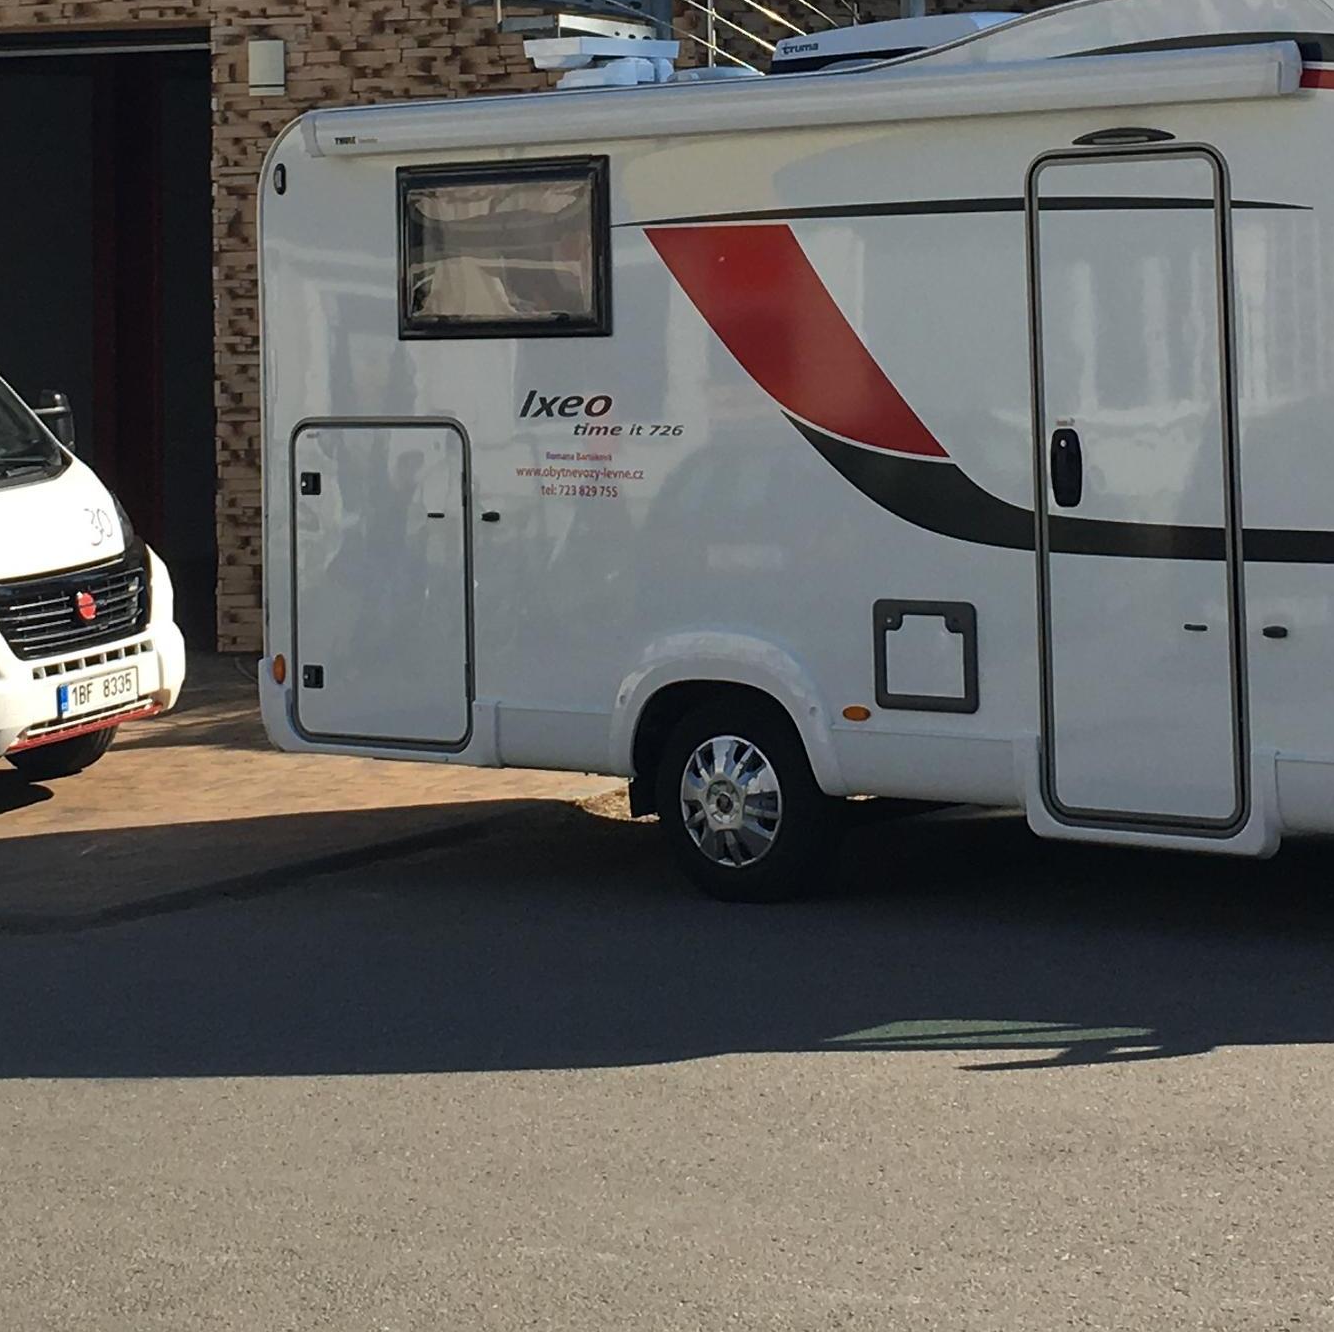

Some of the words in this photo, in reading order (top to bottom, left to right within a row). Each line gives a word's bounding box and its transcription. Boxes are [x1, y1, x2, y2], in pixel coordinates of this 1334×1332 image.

[782, 43, 819, 55] truma
[519, 390, 613, 418] Ixeo
[573, 423, 623, 436] time
[629, 424, 644, 436] it
[649, 425, 684, 436] 726
[516, 465, 644, 481] www.obytnevozy-levne.cz
[558, 484, 577, 496] 723
[578, 485, 598, 497] 829
[600, 486, 619, 498] 755
[72, 682, 94, 706] 1BF
[103, 672, 132, 698] 8335
